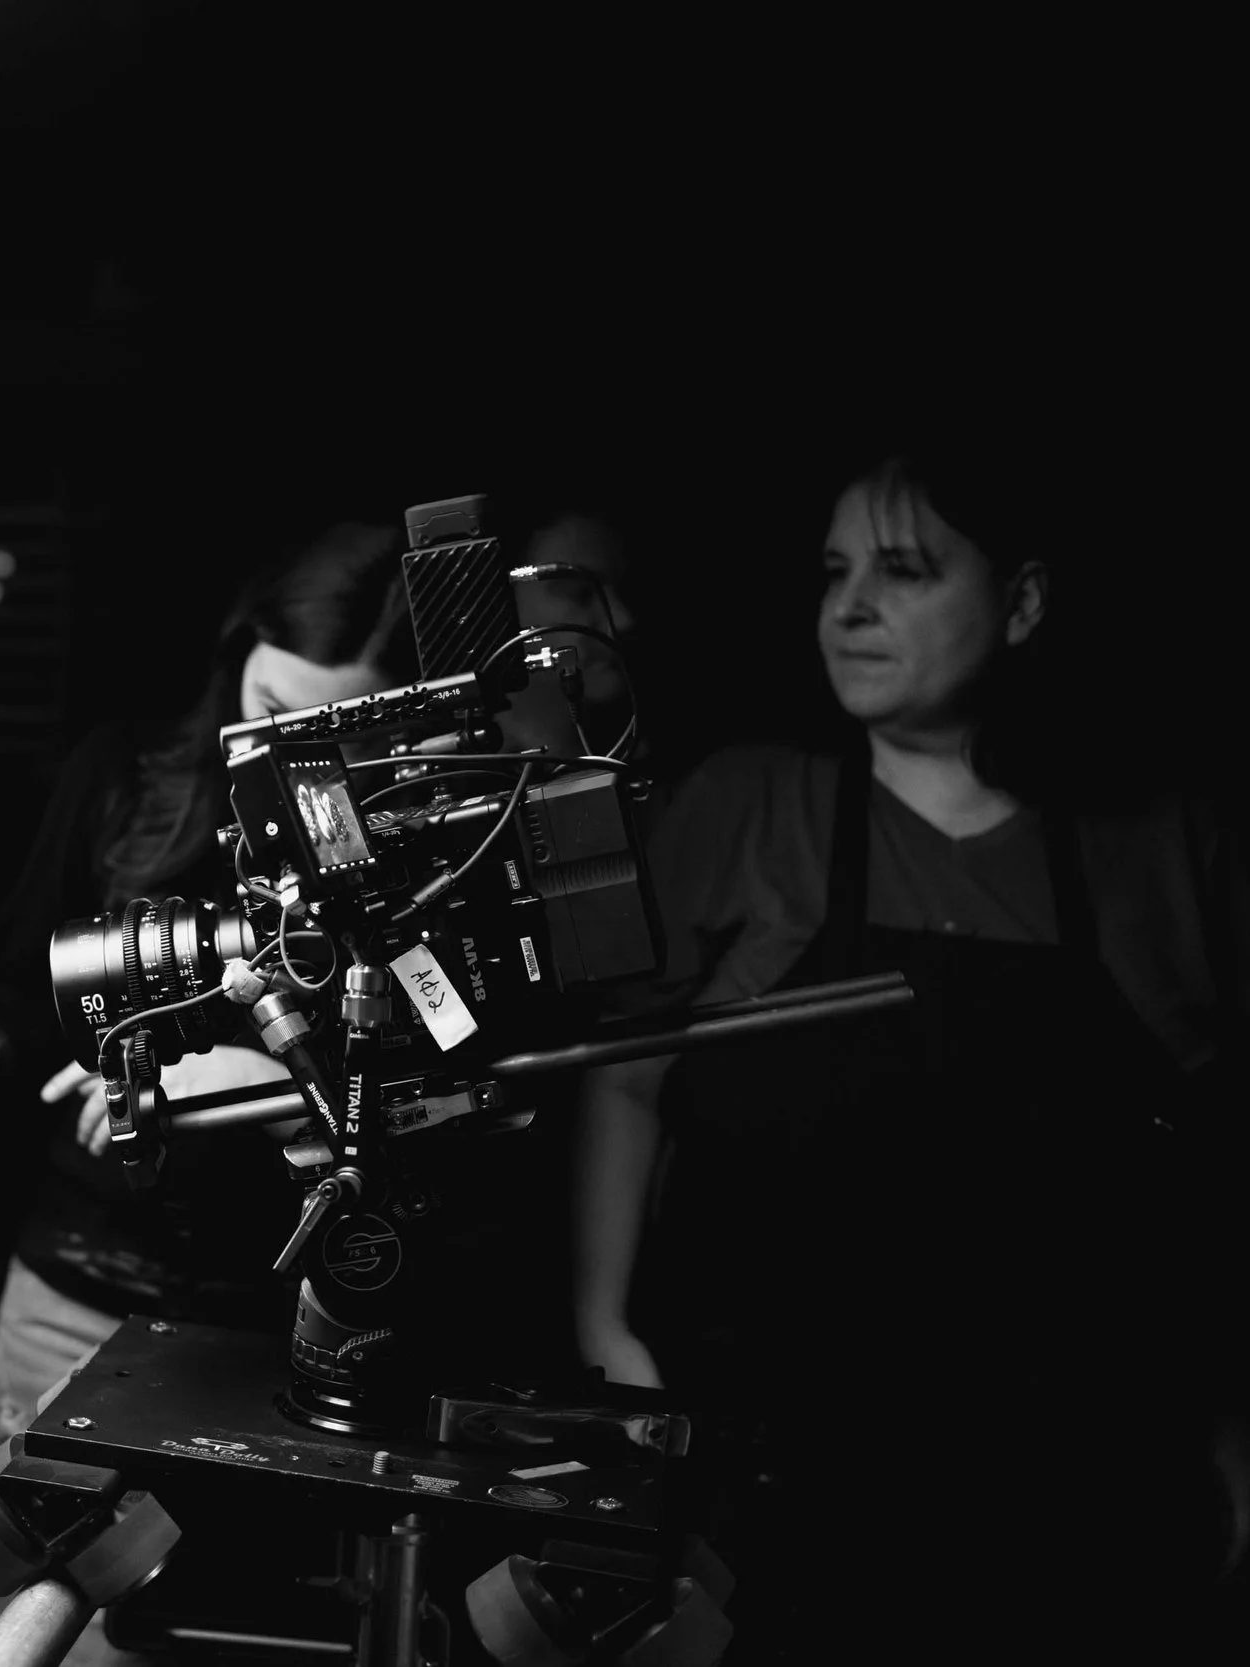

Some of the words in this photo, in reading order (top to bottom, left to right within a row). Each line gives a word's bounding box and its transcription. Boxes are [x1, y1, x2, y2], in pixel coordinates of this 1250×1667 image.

[81, 993, 105, 1014] 50
[86, 1013, 107, 1025] T1.5
[347, 1073, 362, 1120] TITAN
[346, 1121, 359, 1134] 2
